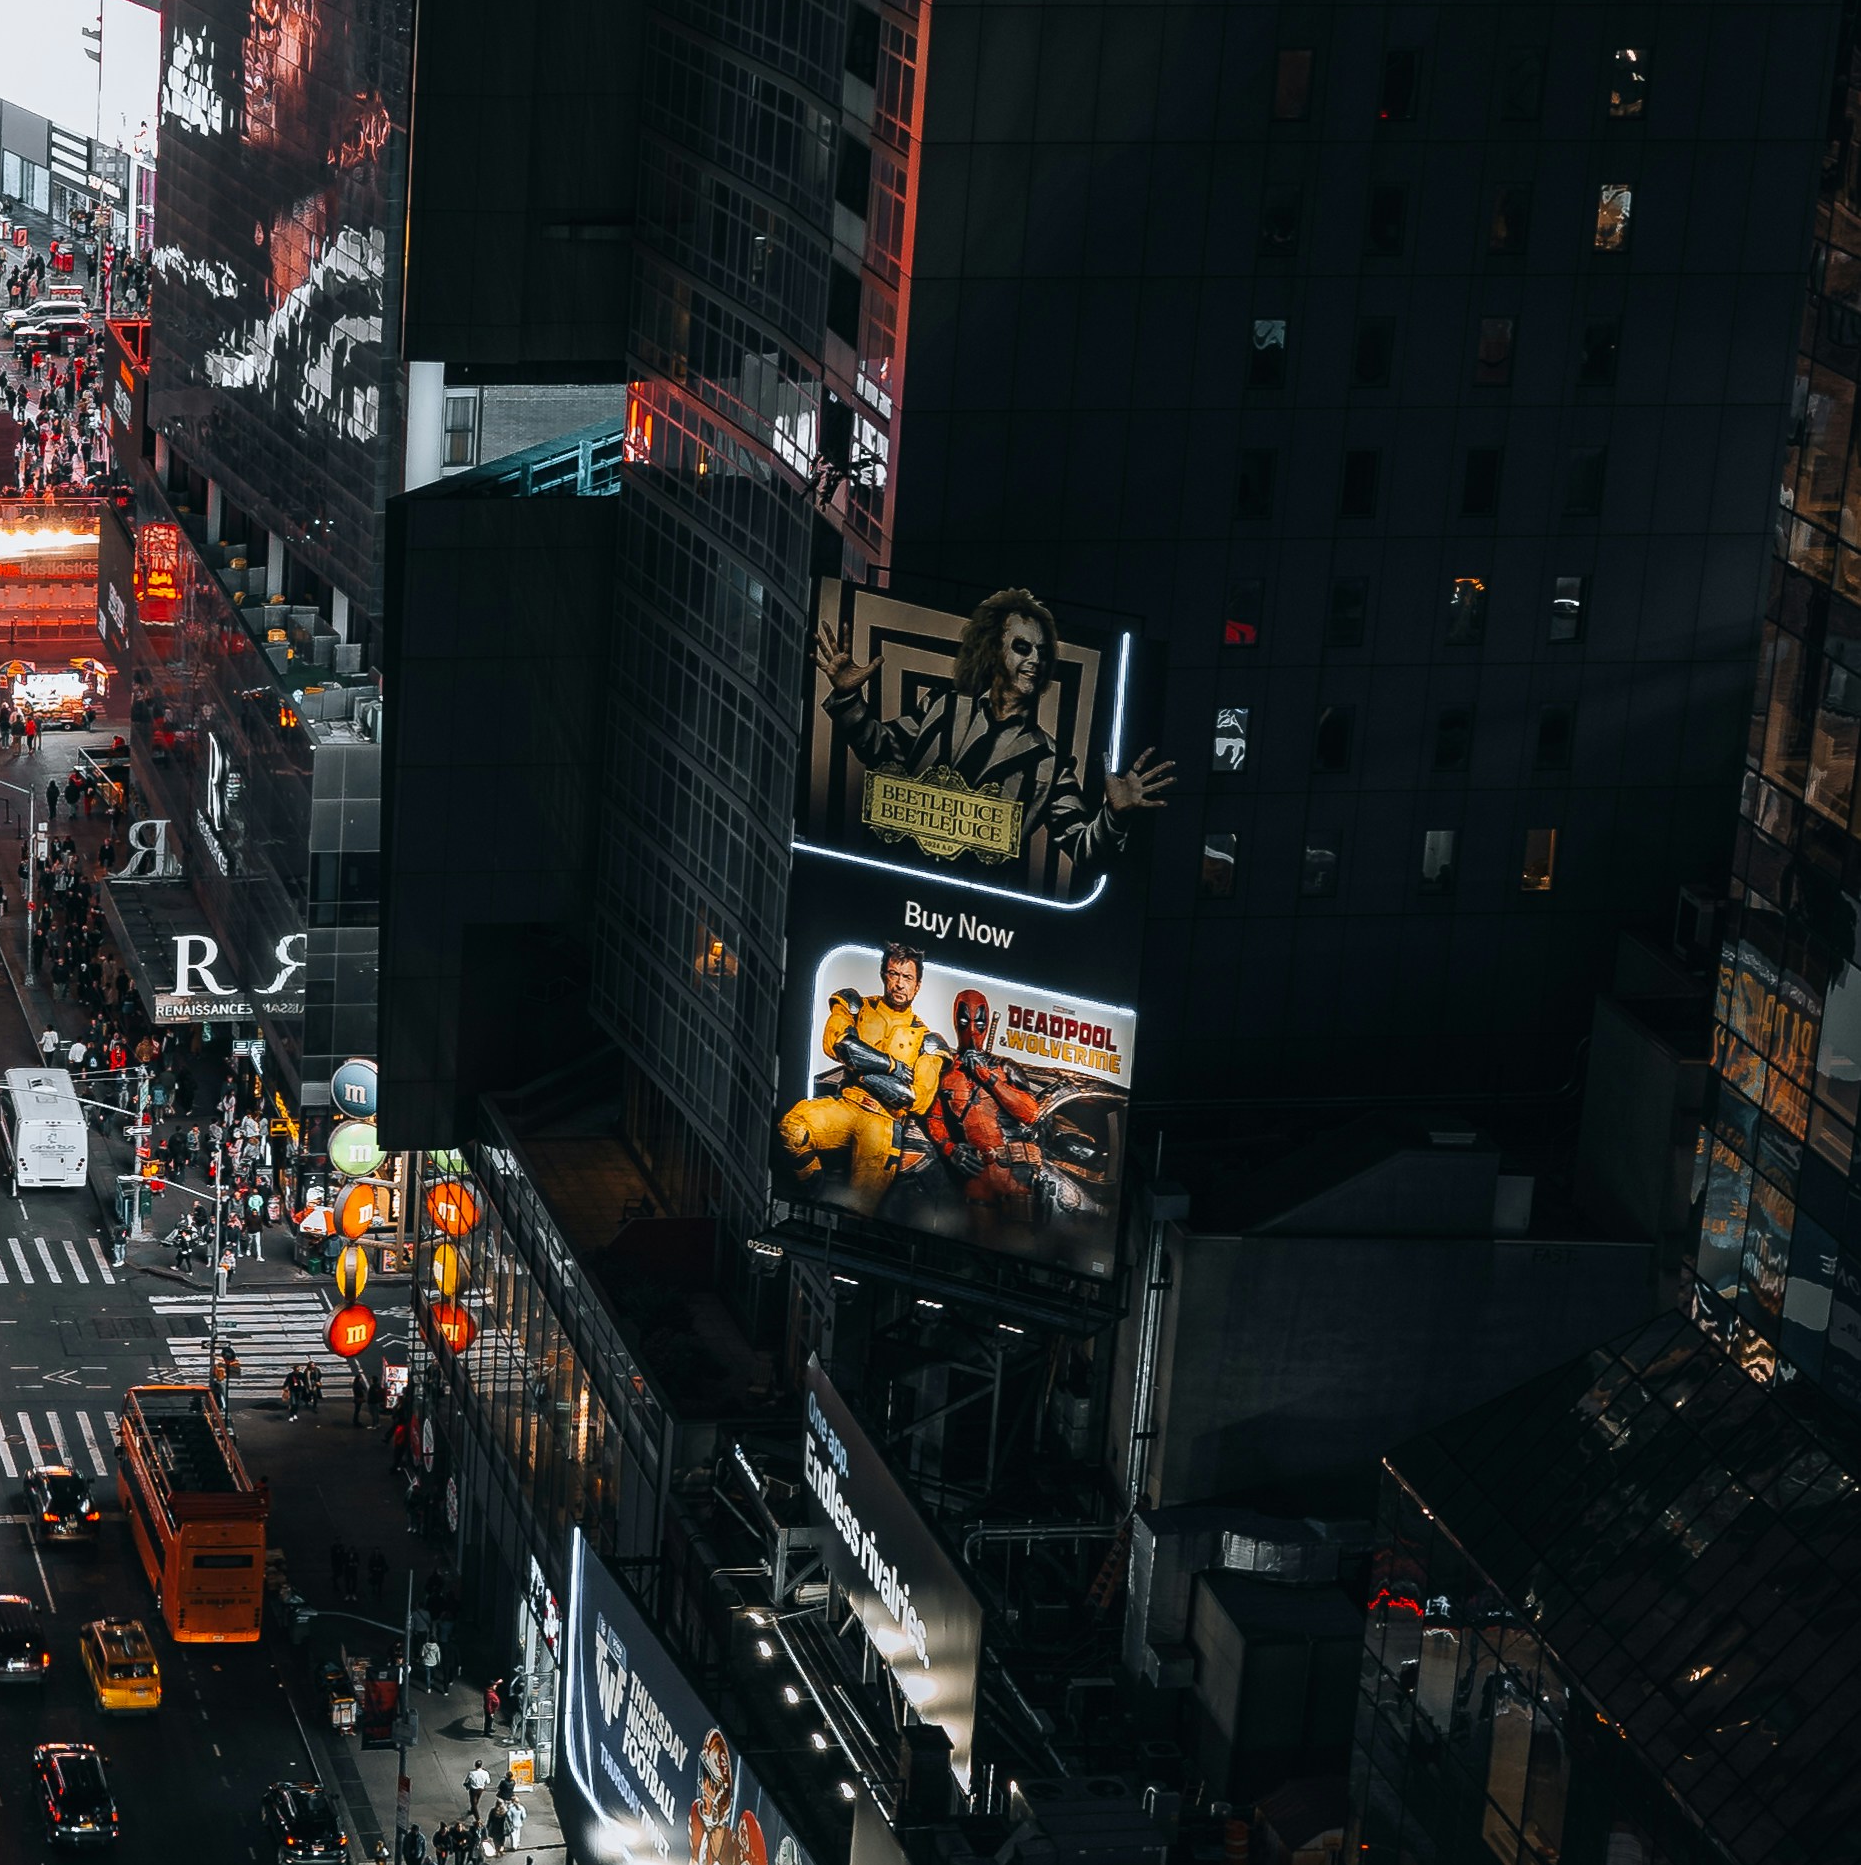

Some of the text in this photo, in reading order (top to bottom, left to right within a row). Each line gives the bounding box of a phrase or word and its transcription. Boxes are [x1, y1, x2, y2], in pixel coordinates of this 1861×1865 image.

[880, 802, 1002, 843] BEETLEJUICE
[882, 784, 1004, 824] BEETLEJUICE
[904, 900, 1014, 948] Buy Now
[171, 935, 238, 996] R
[156, 1003, 247, 1017] RENAISSANCE
[1008, 1004, 1118, 1052] DEADPOOL
[344, 1083, 367, 1105] m
[349, 1144, 373, 1163] m
[359, 1204, 374, 1223] m
[346, 1323, 367, 1344] m
[807, 1391, 849, 1478] One app.
[804, 1431, 931, 1670] Endless rivalries.
[625, 1700, 662, 1769] NIGHT
[629, 1669, 688, 1772] THURSDAY
[600, 1741, 641, 1818] THURSDAY
[622, 1726, 675, 1826] FOOTBALL
